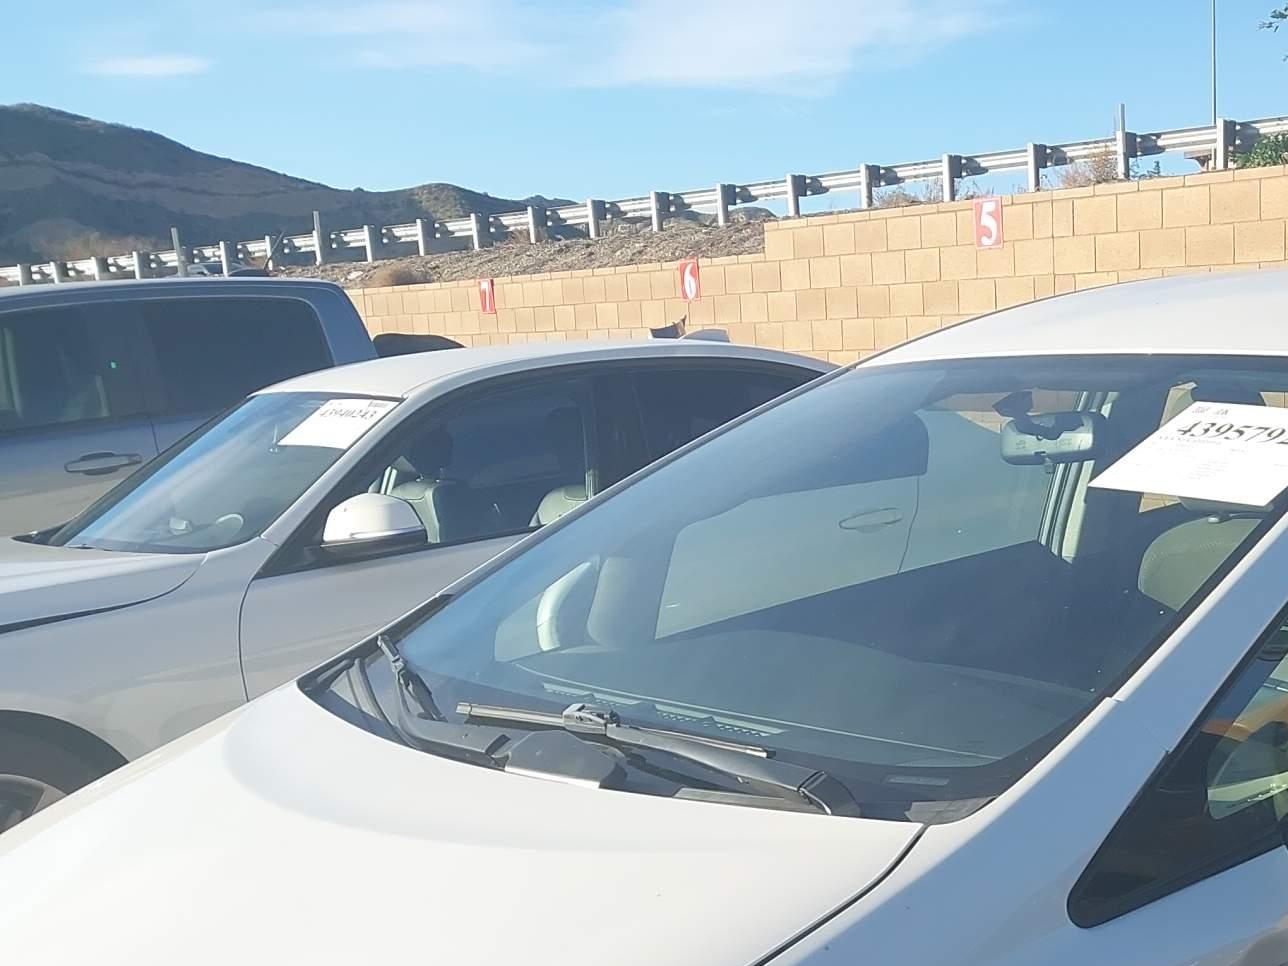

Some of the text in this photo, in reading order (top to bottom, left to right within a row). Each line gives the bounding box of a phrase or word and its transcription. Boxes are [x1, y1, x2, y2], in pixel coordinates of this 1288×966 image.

[980, 200, 998, 246] 5
[480, 280, 491, 312] 7
[684, 262, 697, 300] 6
